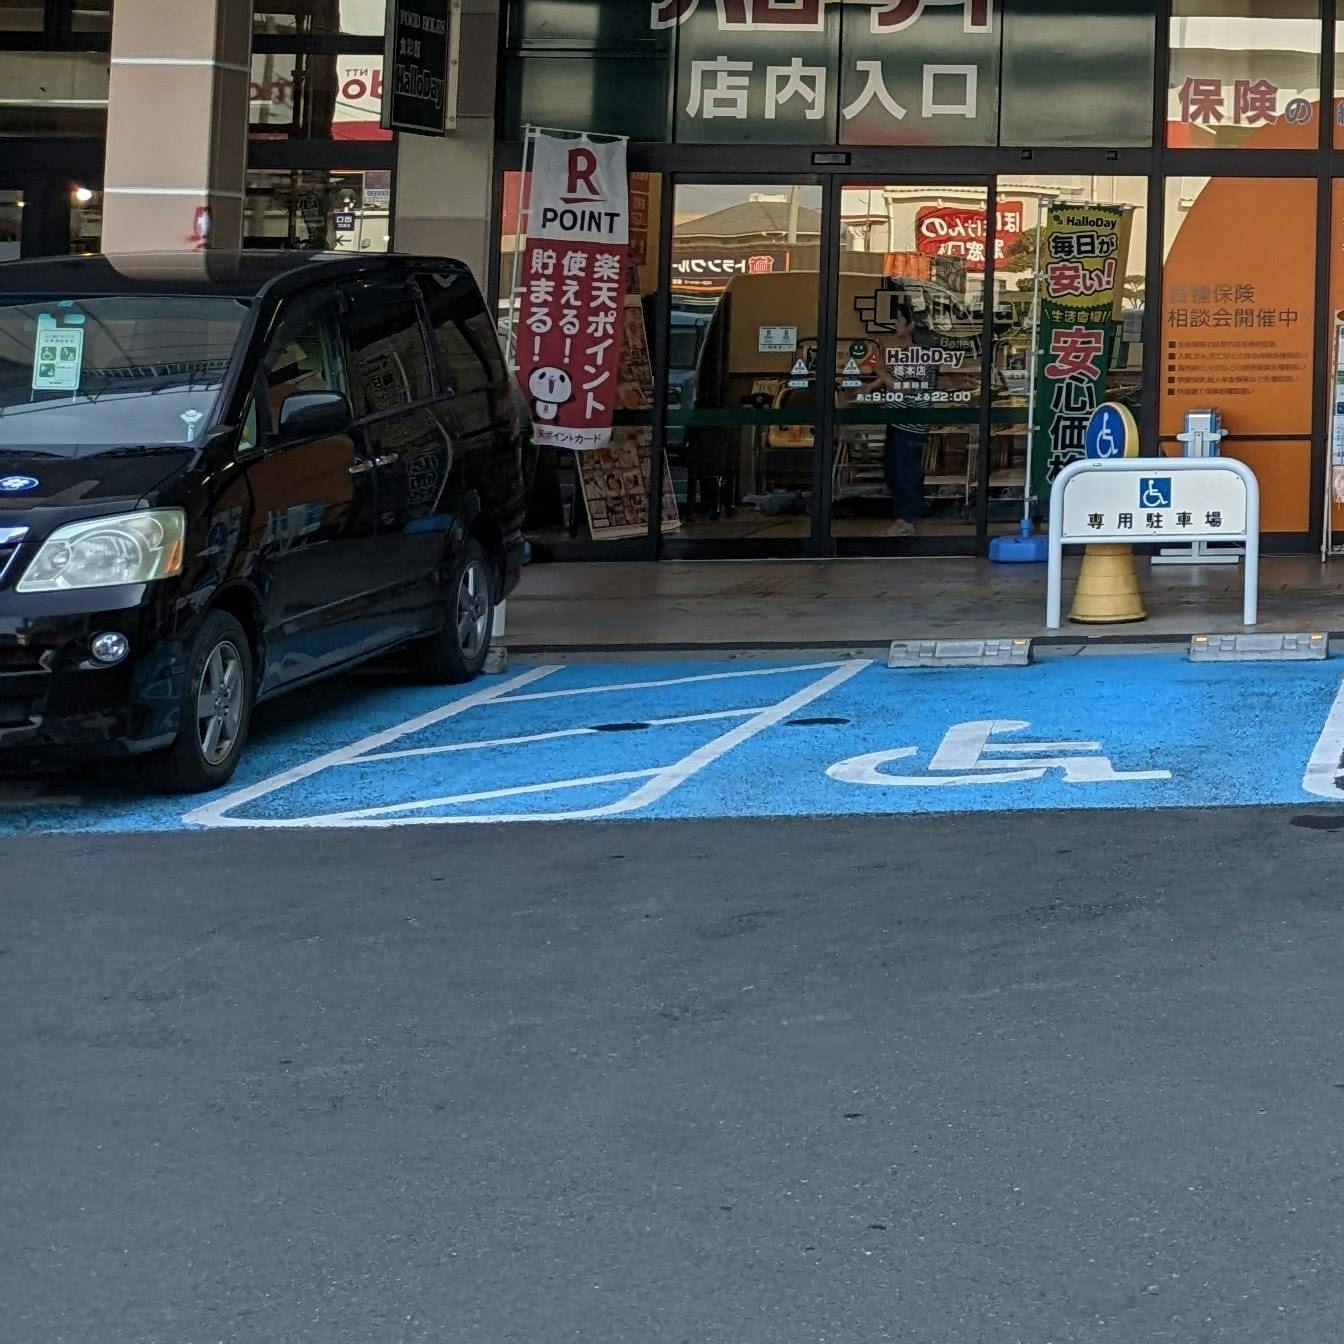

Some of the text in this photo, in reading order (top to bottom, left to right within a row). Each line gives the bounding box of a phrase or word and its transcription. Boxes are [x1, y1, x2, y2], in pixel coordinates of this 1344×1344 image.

[686, 56, 978, 120] 店内入口
[541, 207, 621, 234] POINT
[1050, 233, 1115, 258] 毎日が
[1167, 307, 1299, 328] 相談会開催中
[582, 253, 621, 420] 楽天ポイント
[885, 346, 965, 368] HalloDay
[1087, 510, 1223, 530] 専用駐車場
